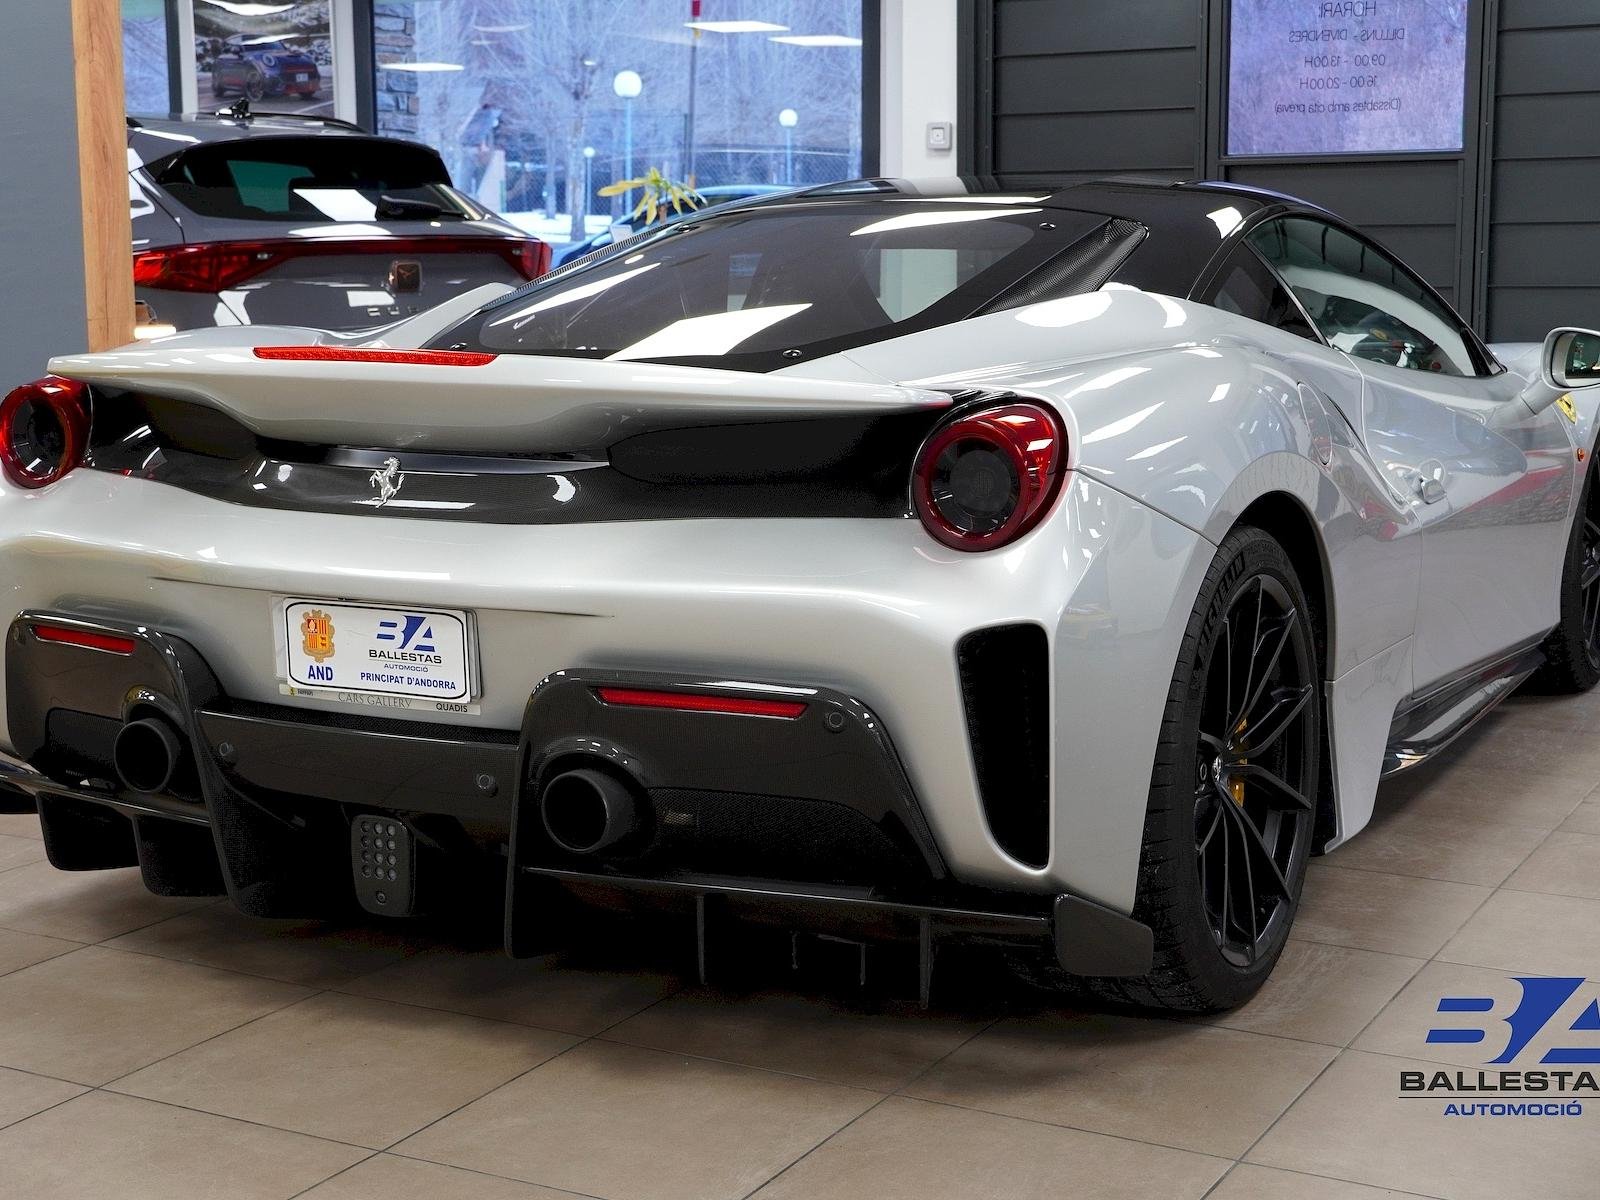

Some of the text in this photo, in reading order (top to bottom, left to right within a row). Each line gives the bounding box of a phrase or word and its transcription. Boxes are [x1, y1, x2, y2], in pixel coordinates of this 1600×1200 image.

[368, 649, 442, 664] BALLESTAS
[308, 665, 333, 681] AND
[383, 663, 429, 673] AUTOMOCIÓ
[360, 672, 456, 690] PRINCIPAT D'ANDORRA
[338, 692, 364, 704] CARS
[436, 703, 468, 713] QUADIS
